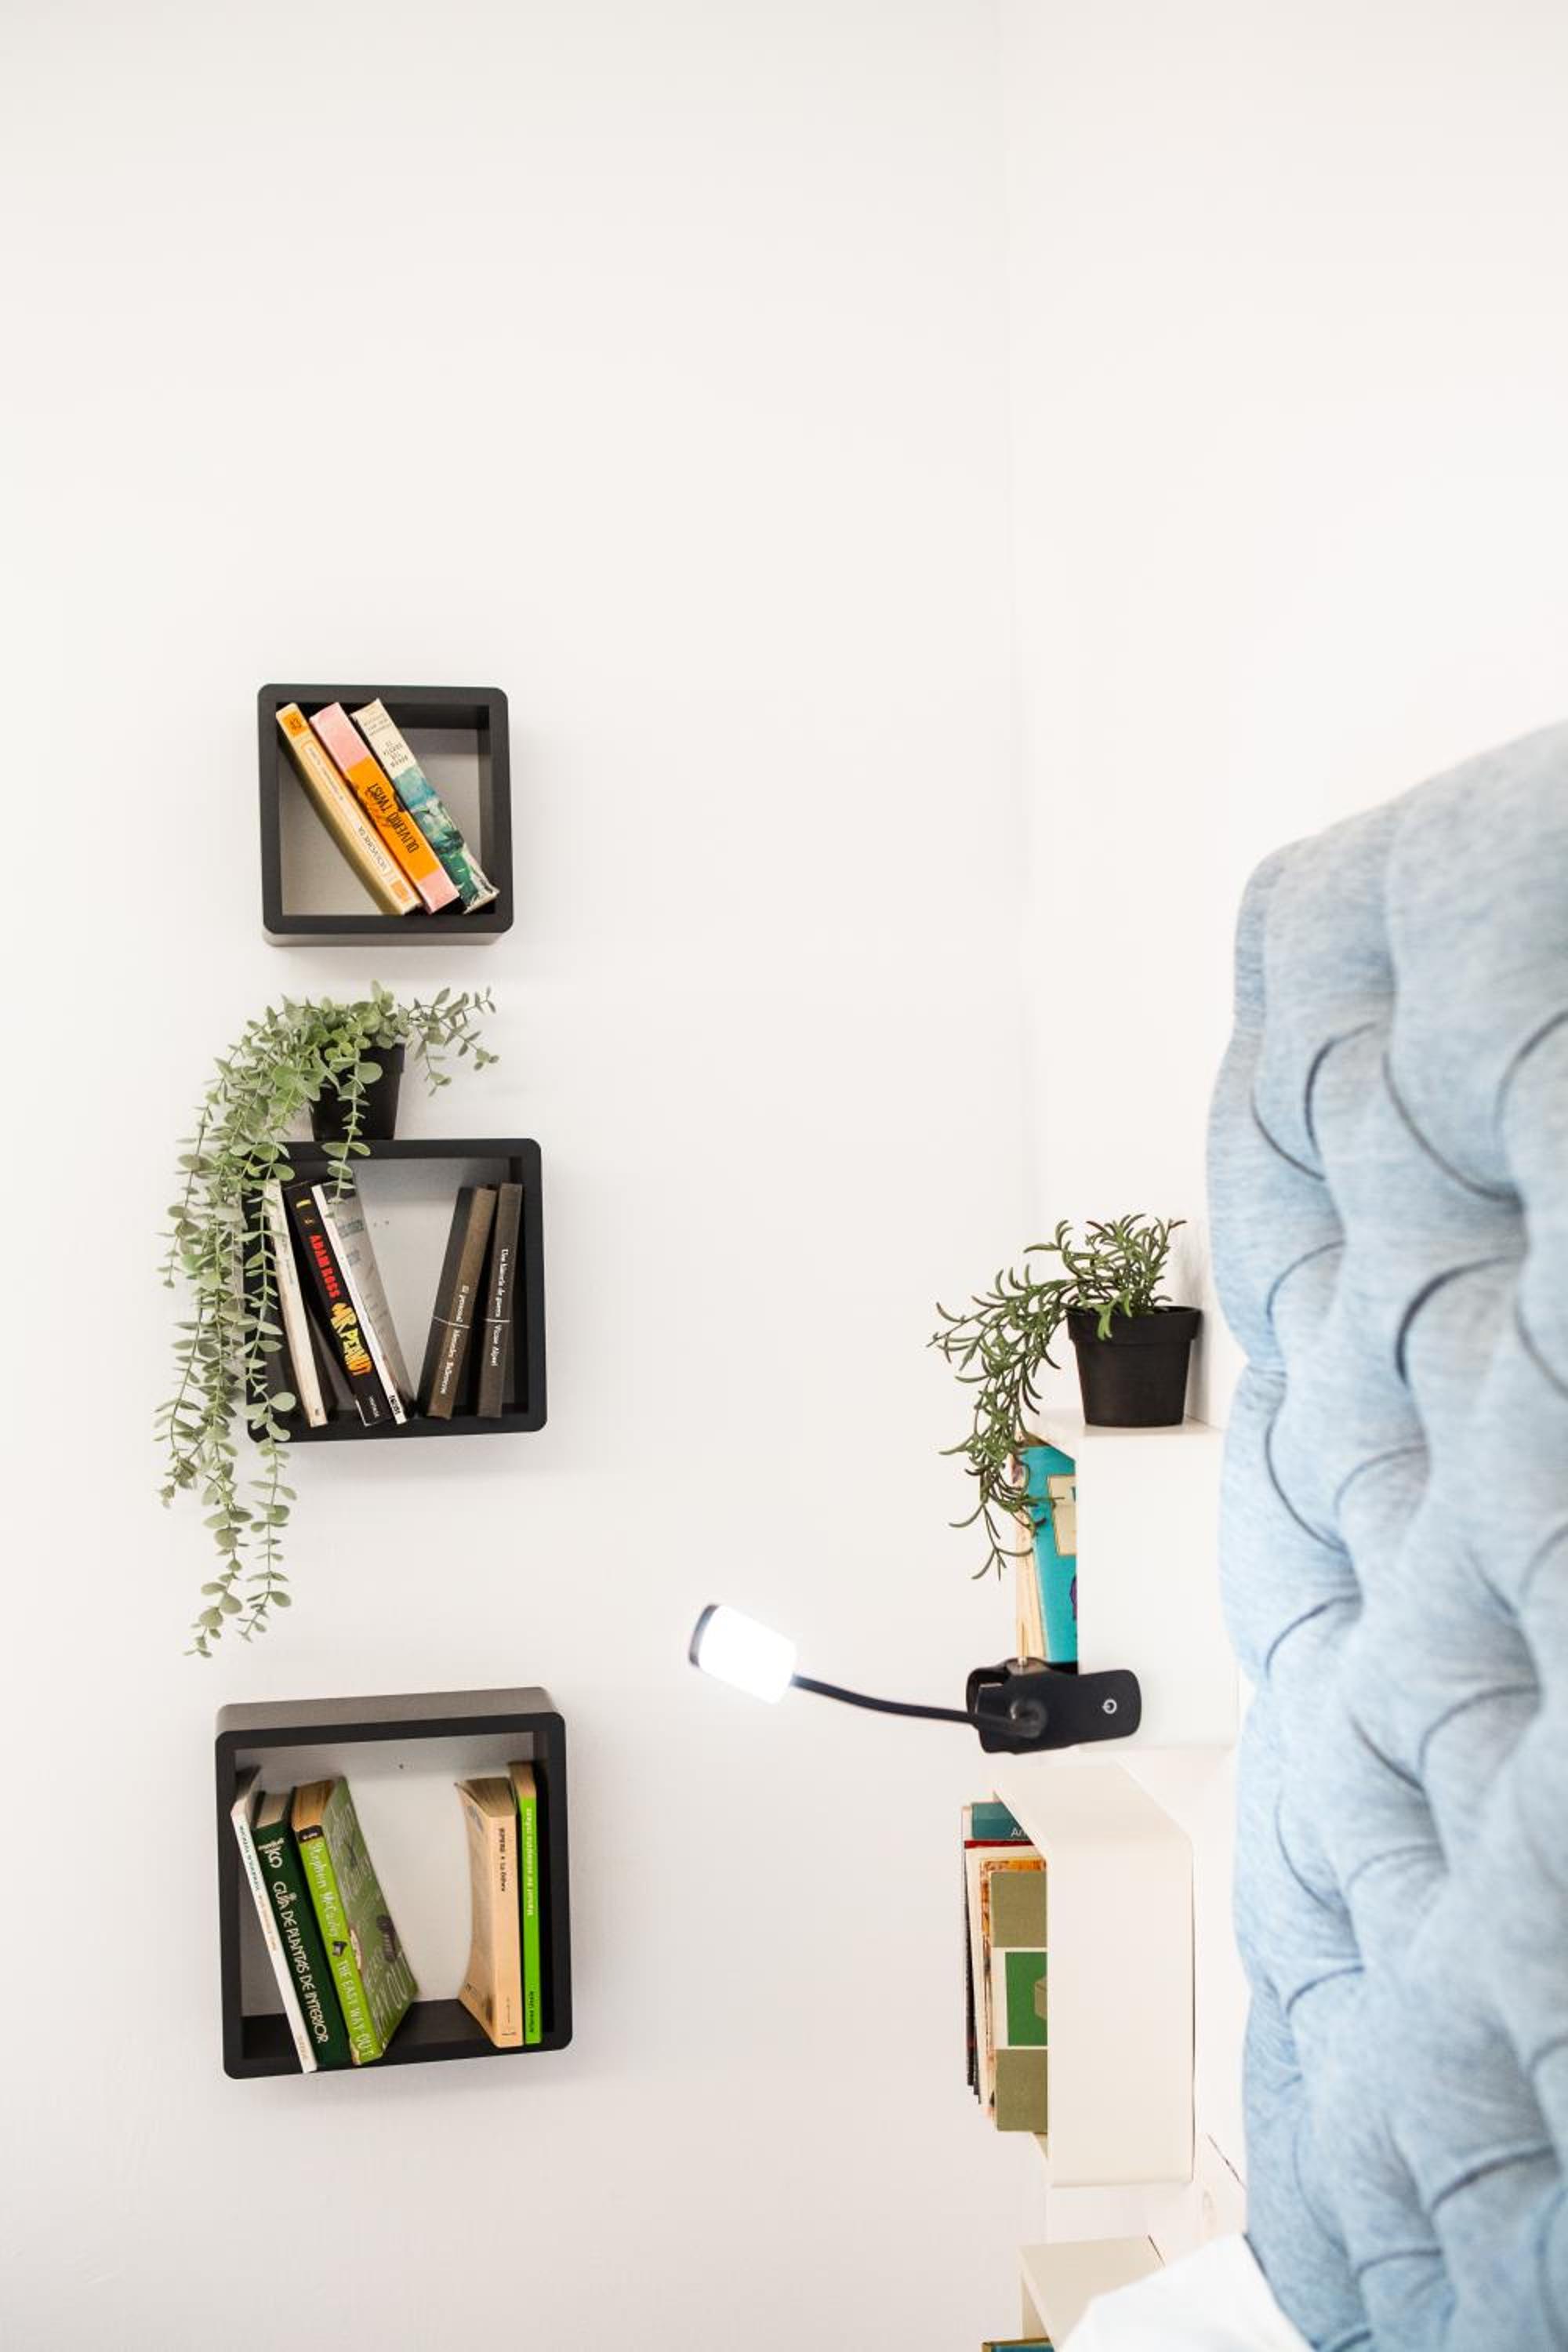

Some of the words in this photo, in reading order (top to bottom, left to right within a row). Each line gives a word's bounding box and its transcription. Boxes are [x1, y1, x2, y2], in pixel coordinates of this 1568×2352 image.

[367, 782, 394, 813] TWIST
[387, 811, 419, 854] OLIVERIO
[310, 1235, 330, 1268] ADAM
[321, 1267, 340, 1298] ROSS
[339, 1327, 372, 1376] PEANUT
[281, 1910, 297, 1928] DE
[285, 1928, 310, 1974] PLANTAS
[299, 1973, 314, 1991] DE
[338, 1959, 351, 1977] THE
[341, 1980, 358, 2005] EASY
[304, 1988, 328, 2044] INTERIOR
[350, 2007, 365, 2031] WAY
